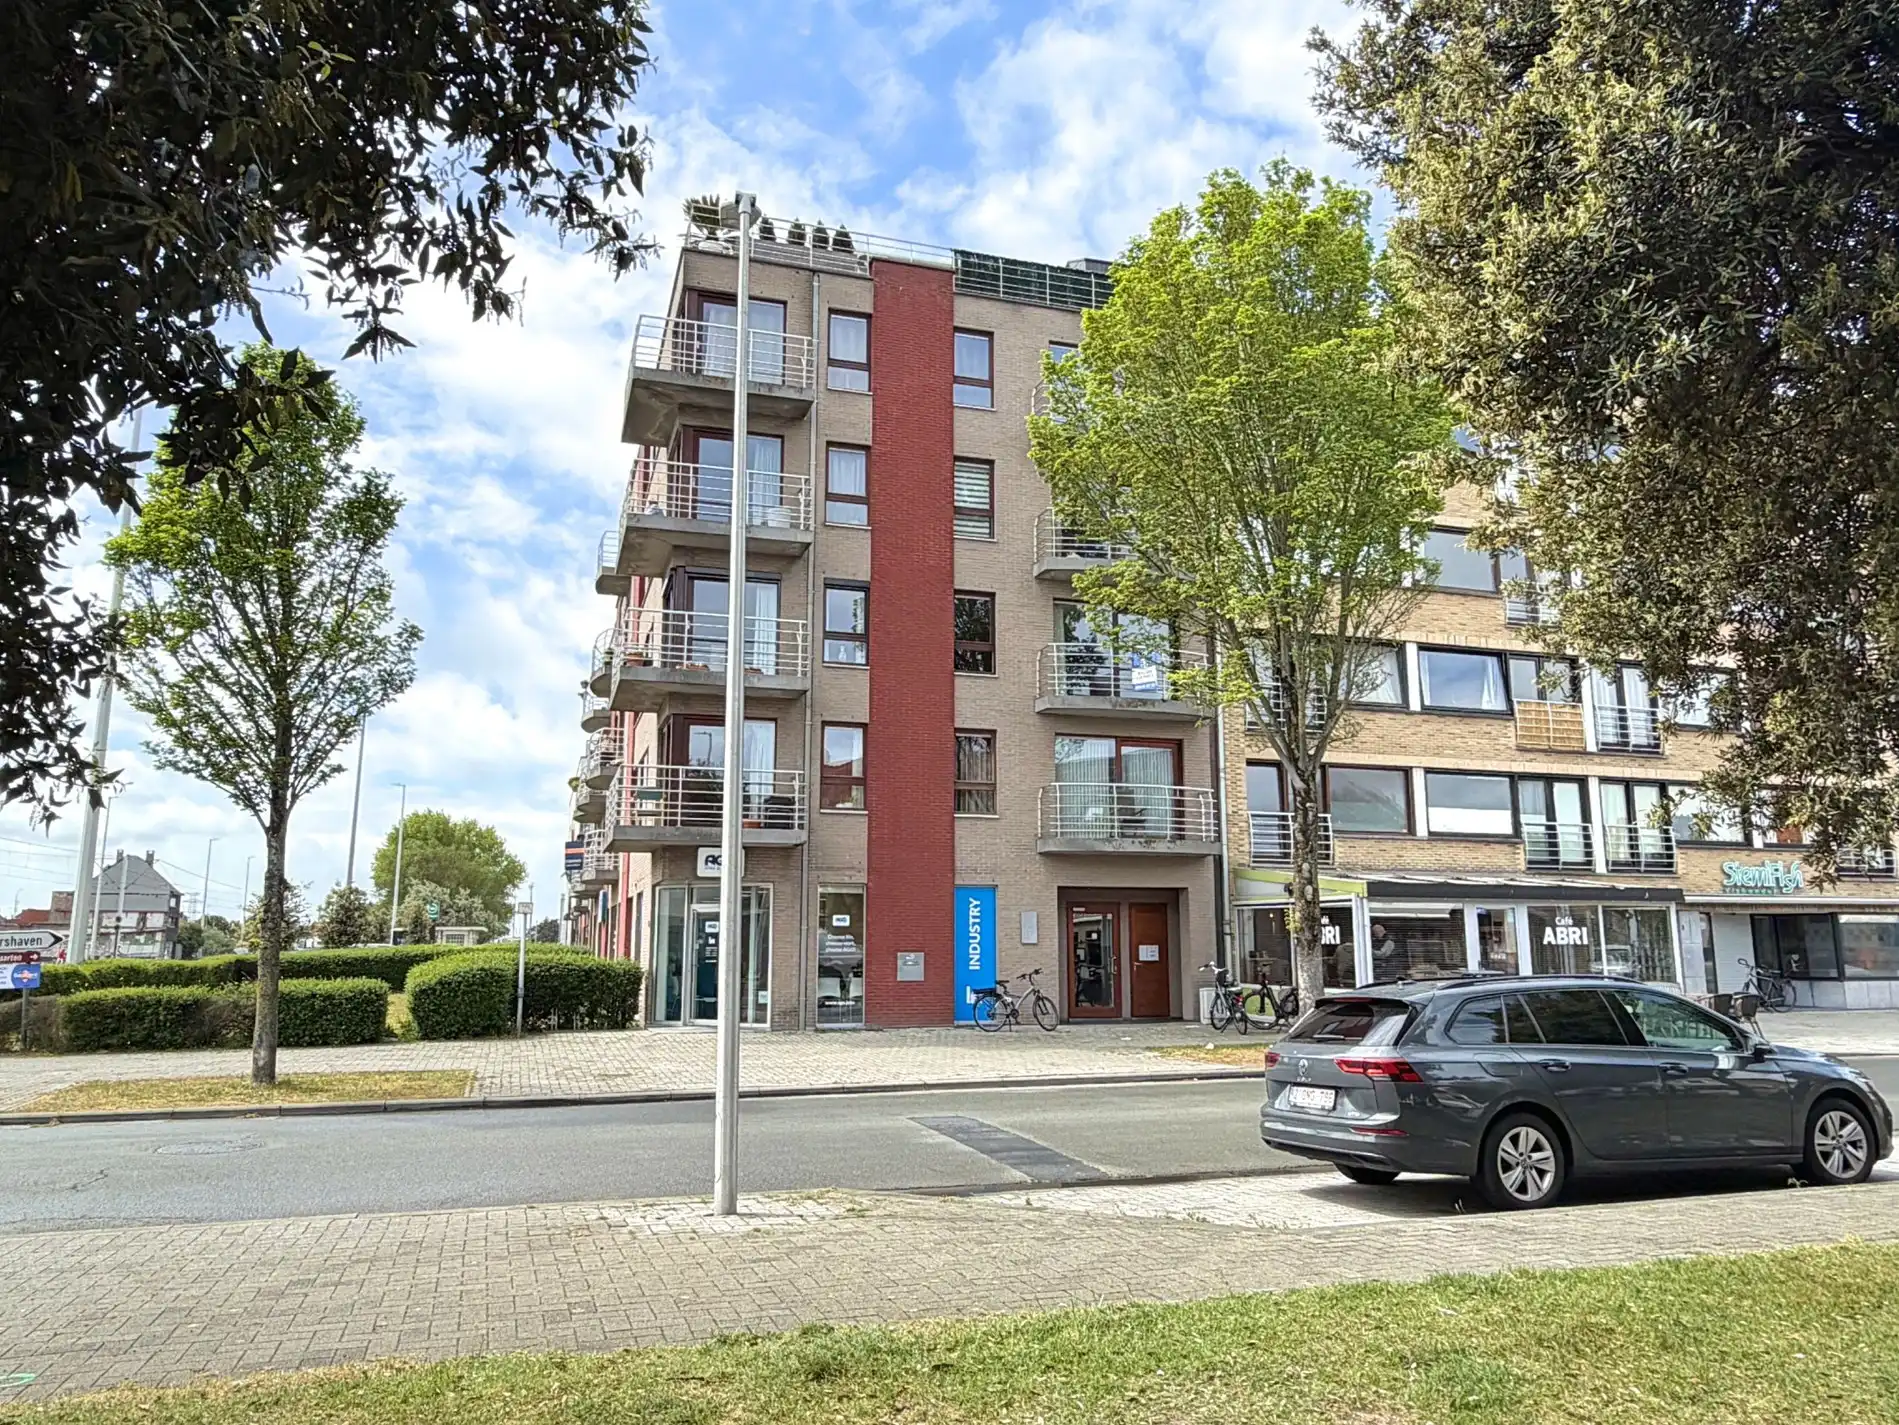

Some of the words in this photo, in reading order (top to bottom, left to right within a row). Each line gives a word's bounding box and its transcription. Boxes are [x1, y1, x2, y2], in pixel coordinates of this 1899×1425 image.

[1555, 916, 1573, 926] Café
[969, 897, 980, 970] INDUSTRY
[1543, 926, 1588, 945] ABRI
